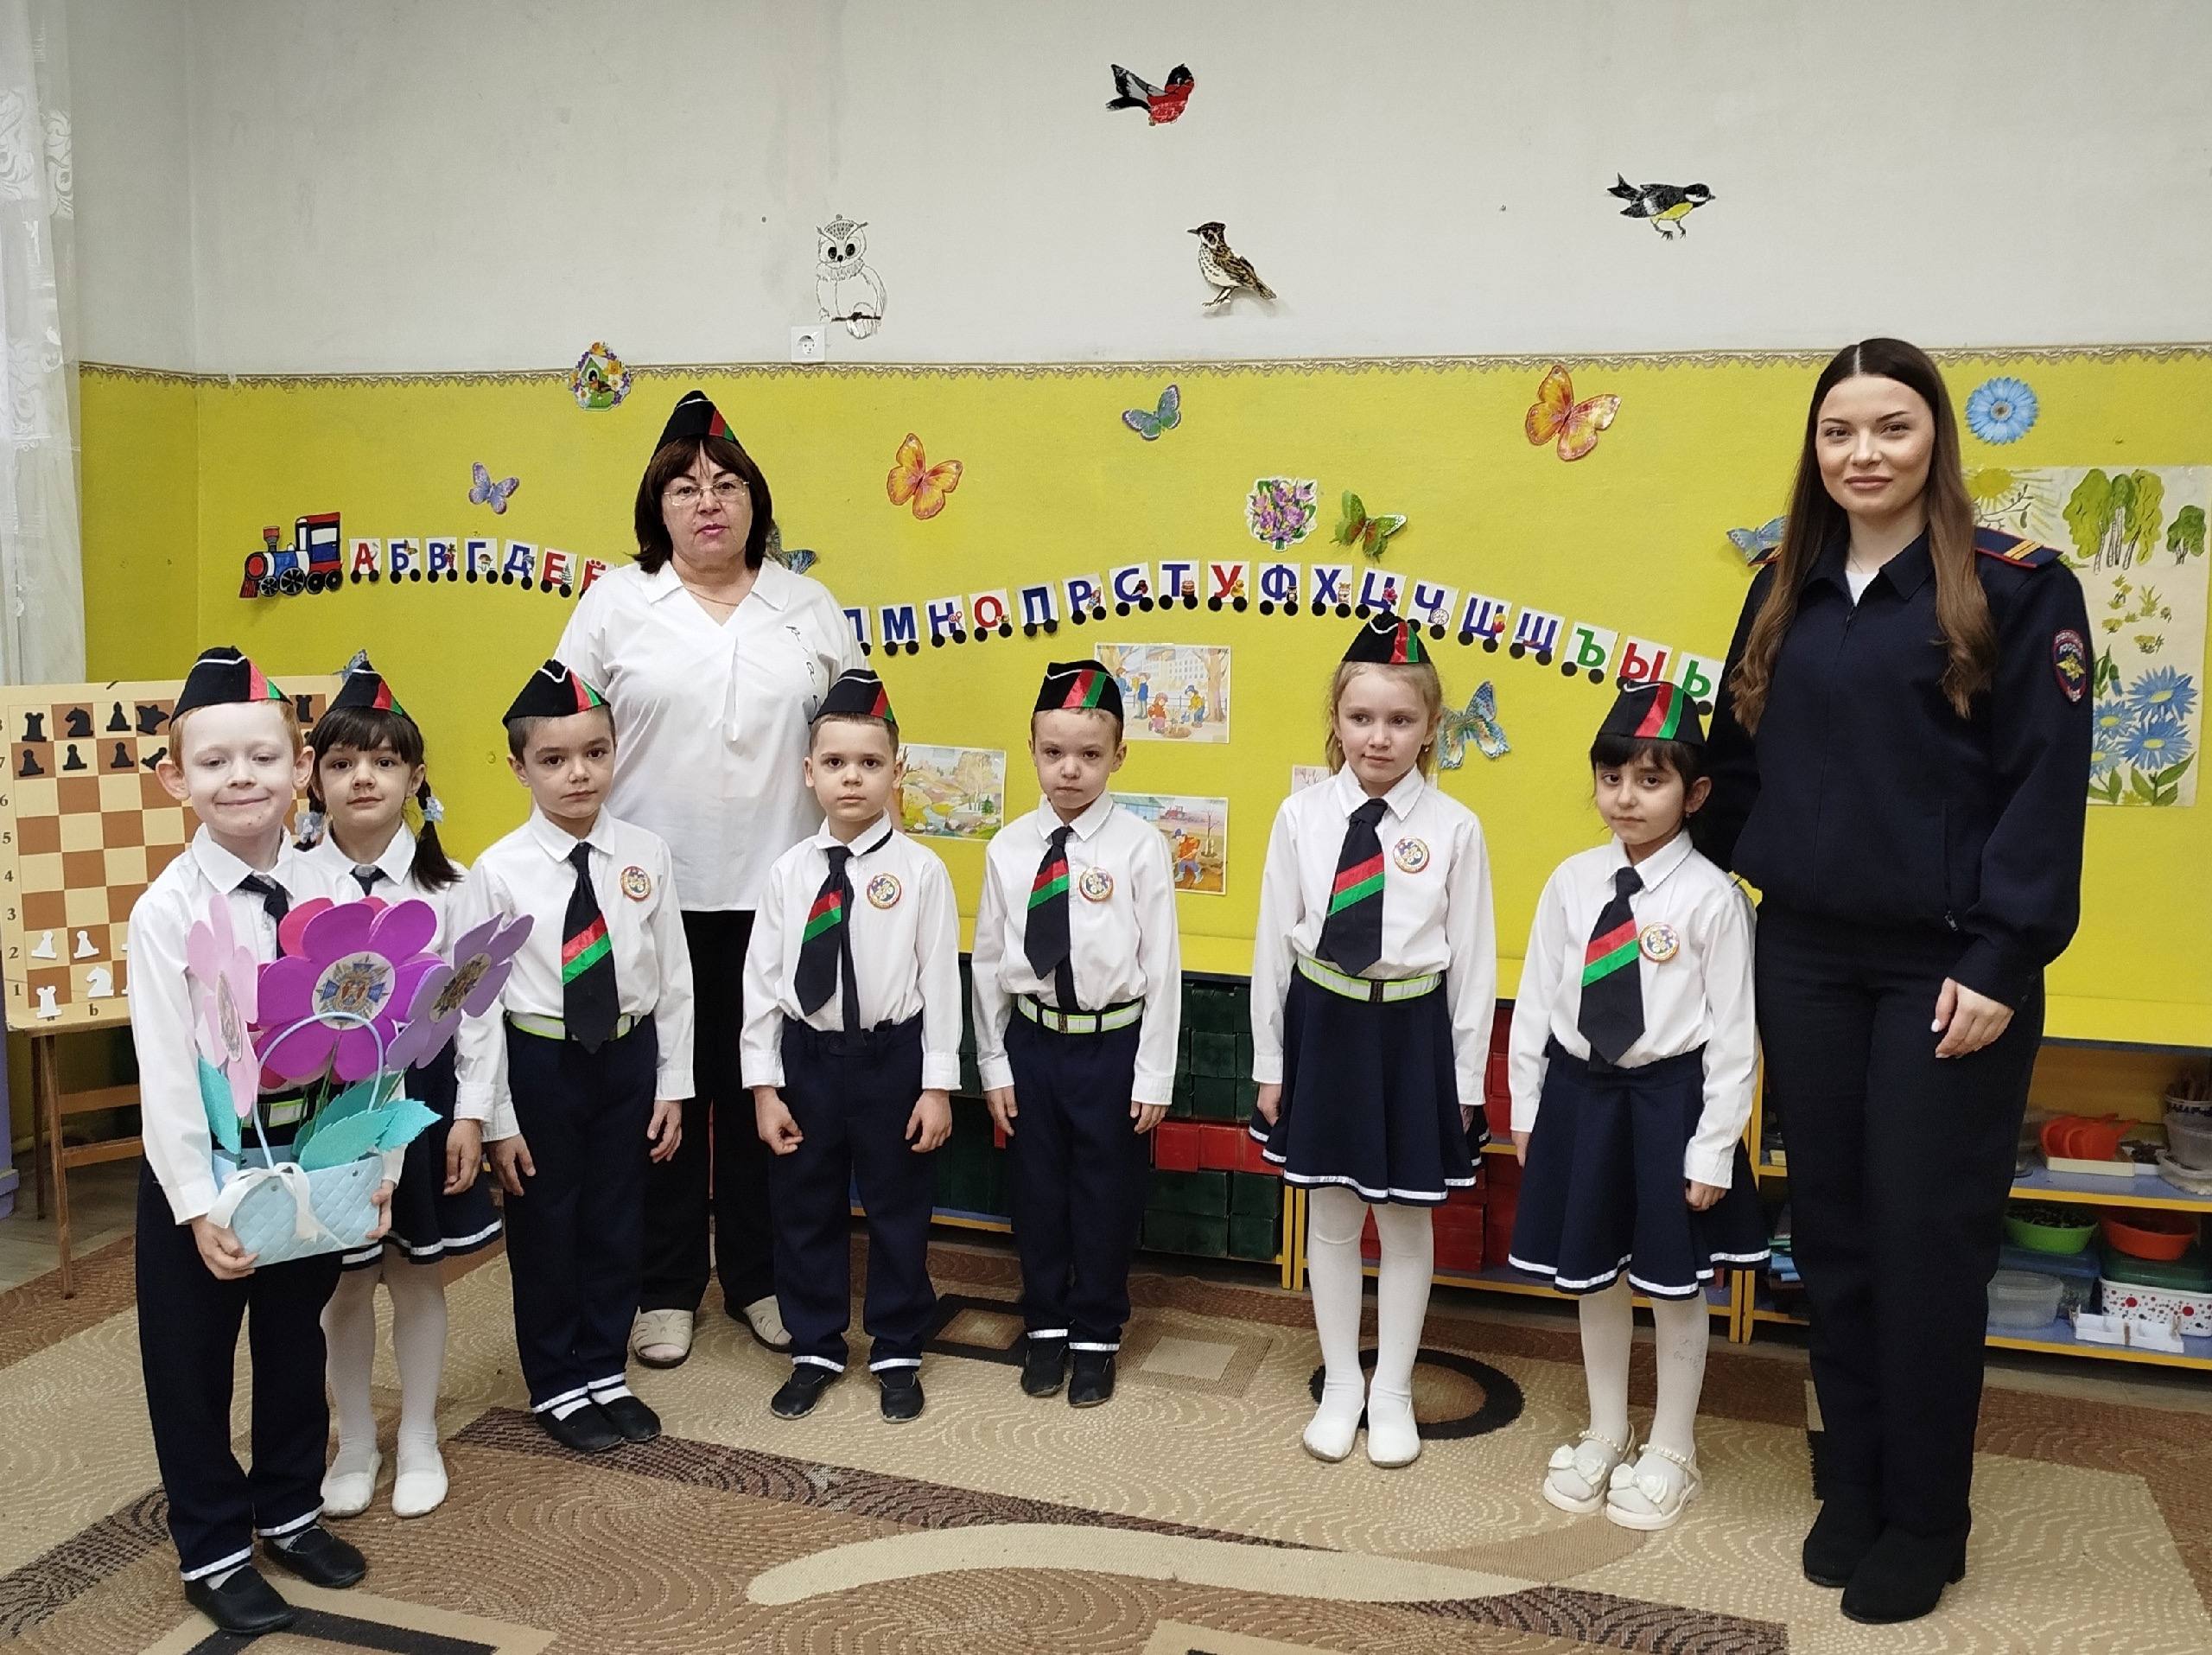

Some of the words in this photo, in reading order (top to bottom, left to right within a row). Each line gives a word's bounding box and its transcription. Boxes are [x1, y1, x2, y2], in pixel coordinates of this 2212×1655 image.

[353, 543, 375, 570] А
[391, 544, 409, 570] Б
[429, 543, 448, 570] В
[468, 542, 486, 571] Г
[504, 544, 531, 576] Д
[543, 551, 566, 584] Е
[882, 607, 916, 641] М
[929, 602, 957, 635] Н
[975, 596, 1002, 627] О
[1022, 587, 1051, 622] П
[1068, 580, 1092, 611] Р
[1115, 568, 1142, 602] С
[1162, 564, 1190, 597] Т
[1211, 565, 1243, 598] У
[1262, 564, 1296, 601] Ф
[1313, 569, 1342, 603] Х
[1360, 572, 1395, 613] Ц
[1415, 584, 1445, 623] Ч
[1576, 627, 1605, 667] Ъ
[1619, 642, 1667, 683] Ы
[1682, 659, 1711, 697] Ь
[0, 793, 9, 806] 6
[2, 831, 12, 844] 5
[4, 869, 14, 882] 4
[7, 907, 16, 920] 3
[9, 946, 19, 959] 2
[14, 983, 22, 996] 1
[89, 1003, 99, 1016] b
